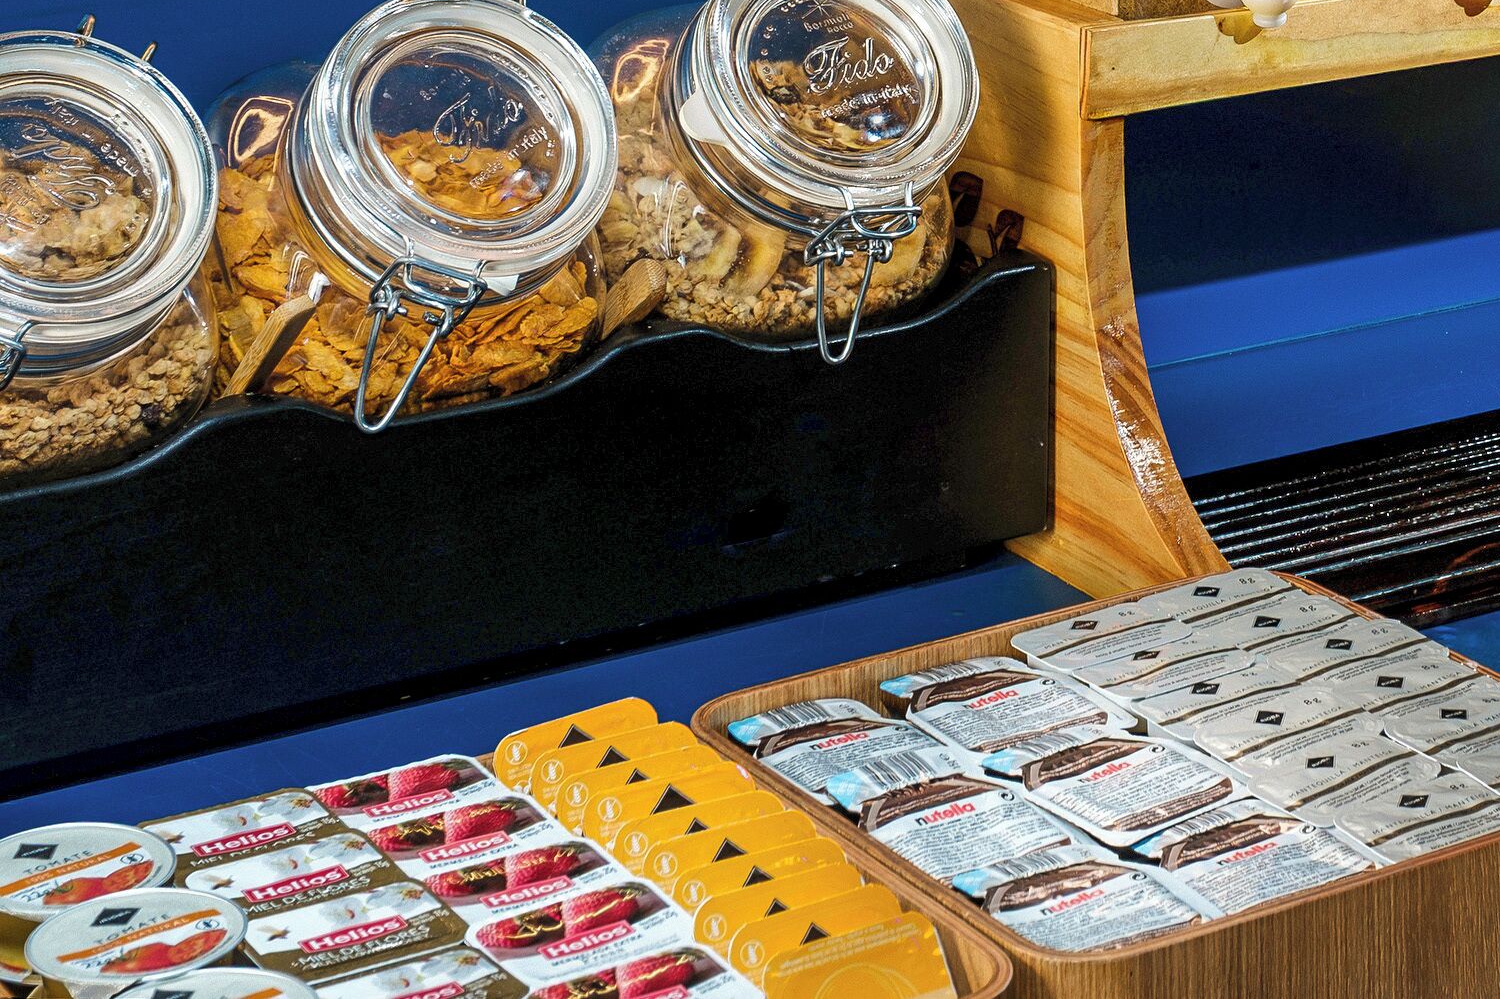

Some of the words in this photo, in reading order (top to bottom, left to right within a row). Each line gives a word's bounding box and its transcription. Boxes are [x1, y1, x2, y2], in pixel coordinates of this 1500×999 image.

[1173, 599, 1225, 618] ANTEQUILLA
[963, 689, 1019, 710] nutella
[810, 731, 870, 750] nutella
[1078, 761, 1132, 783] nutella
[371, 791, 449, 816] Helios
[915, 802, 976, 826] nutella
[202, 824, 290, 855] Helios
[426, 834, 506, 863] Helios
[22, 849, 94, 876] TOMATE
[1216, 841, 1277, 866] nutella
[253, 868, 343, 900] Helios
[488, 878, 569, 907] Helios
[1040, 888, 1105, 916] nutella
[310, 919, 401, 951] Helios
[547, 924, 628, 958] Helios
